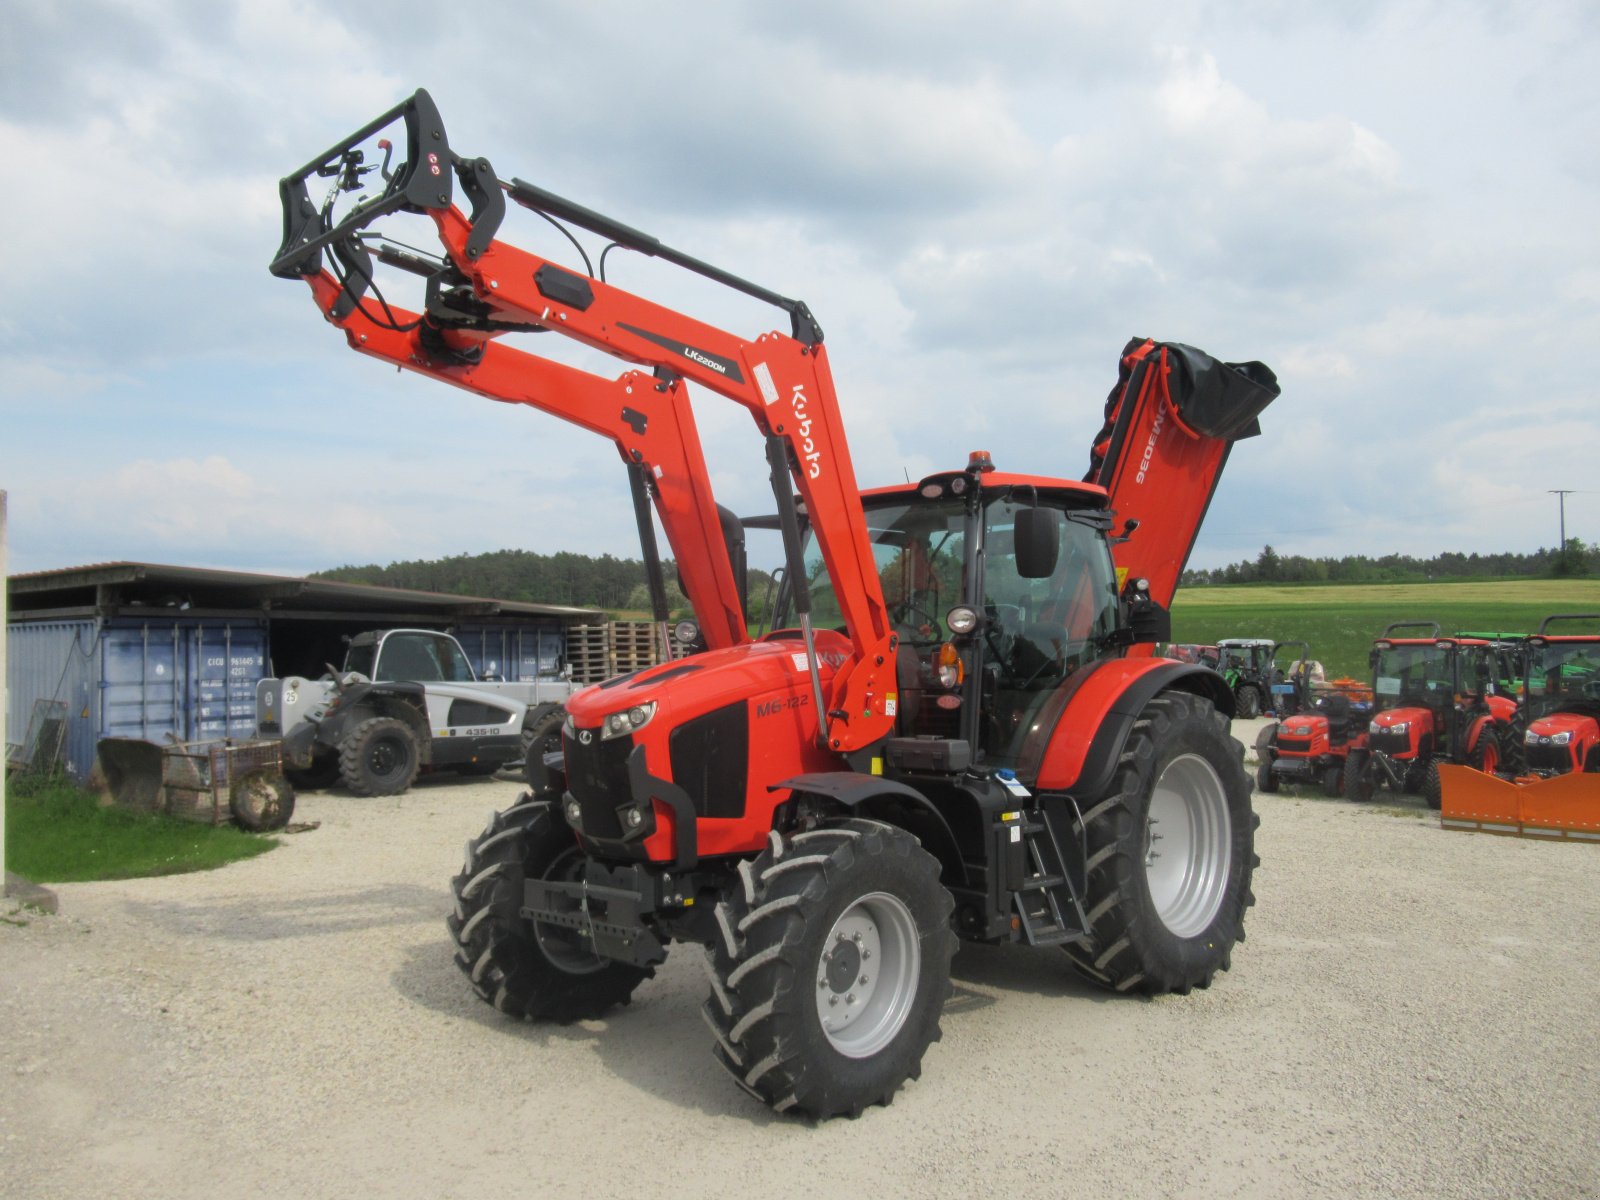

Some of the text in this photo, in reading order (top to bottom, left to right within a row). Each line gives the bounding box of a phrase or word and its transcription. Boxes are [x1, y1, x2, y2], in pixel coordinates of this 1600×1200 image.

[684, 347, 726, 374] LK2200M
[792, 384, 821, 480] Kubota
[286, 692, 296, 702] 25
[757, 694, 809, 719] M6-122
[465, 728, 500, 737] 435-10
